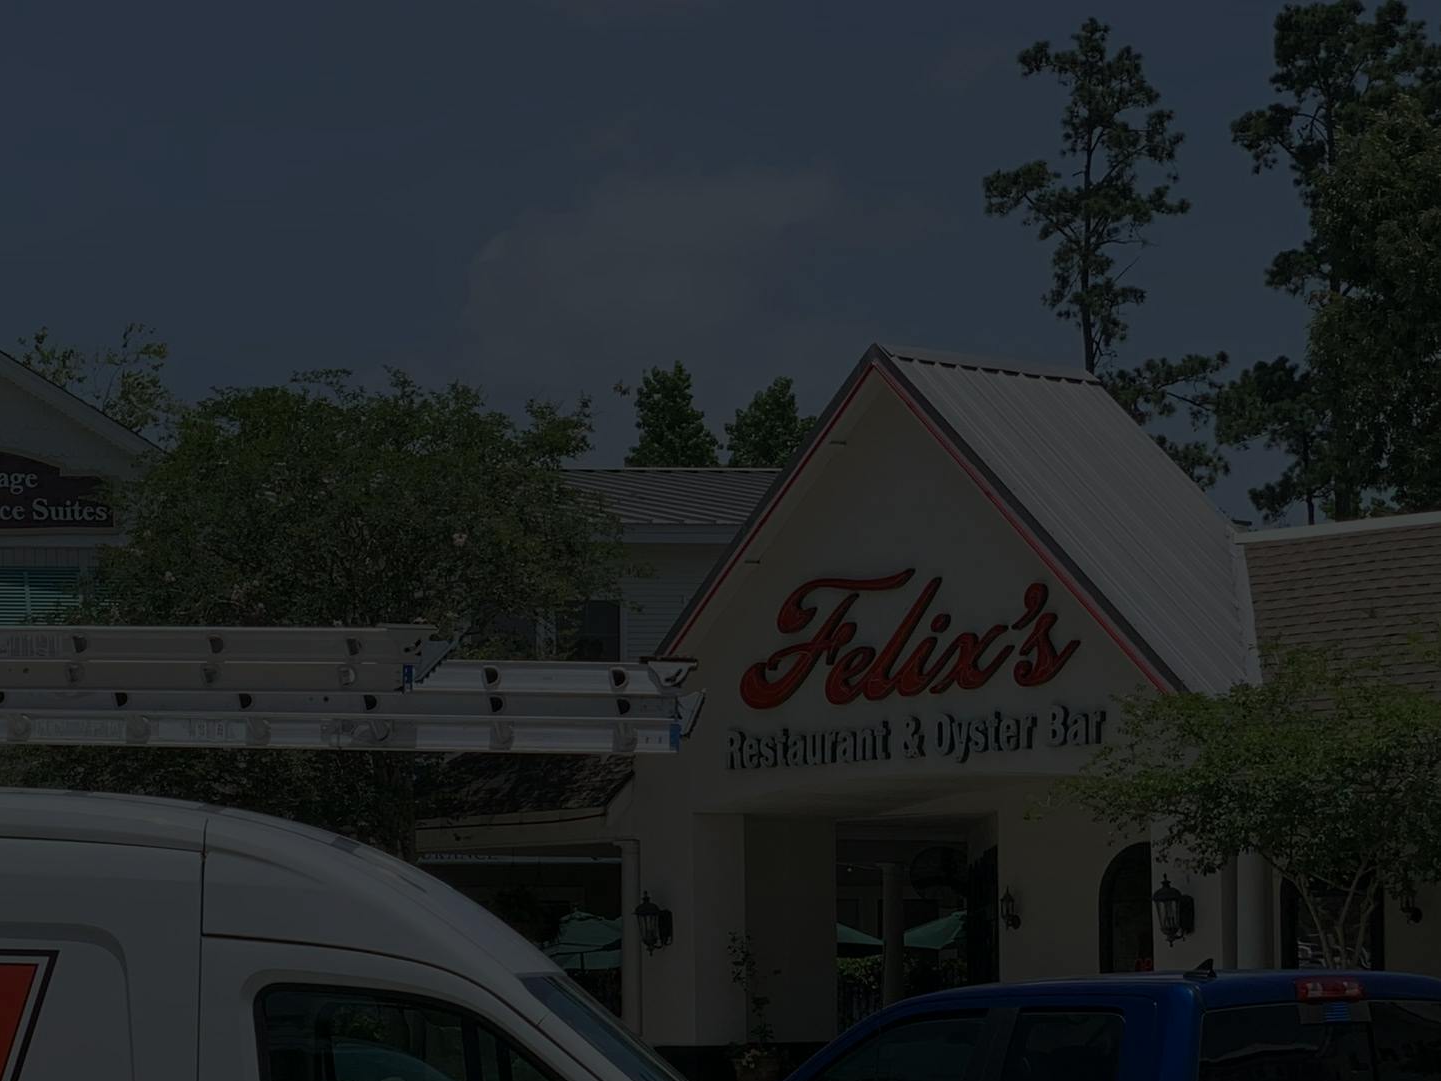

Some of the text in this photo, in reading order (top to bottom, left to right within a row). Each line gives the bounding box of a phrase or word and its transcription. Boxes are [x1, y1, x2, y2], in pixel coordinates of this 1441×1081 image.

[32, 498, 109, 522] Suites
[740, 568, 1081, 710] Felix's
[724, 704, 1107, 770] Restaurant & Oyster Bar
